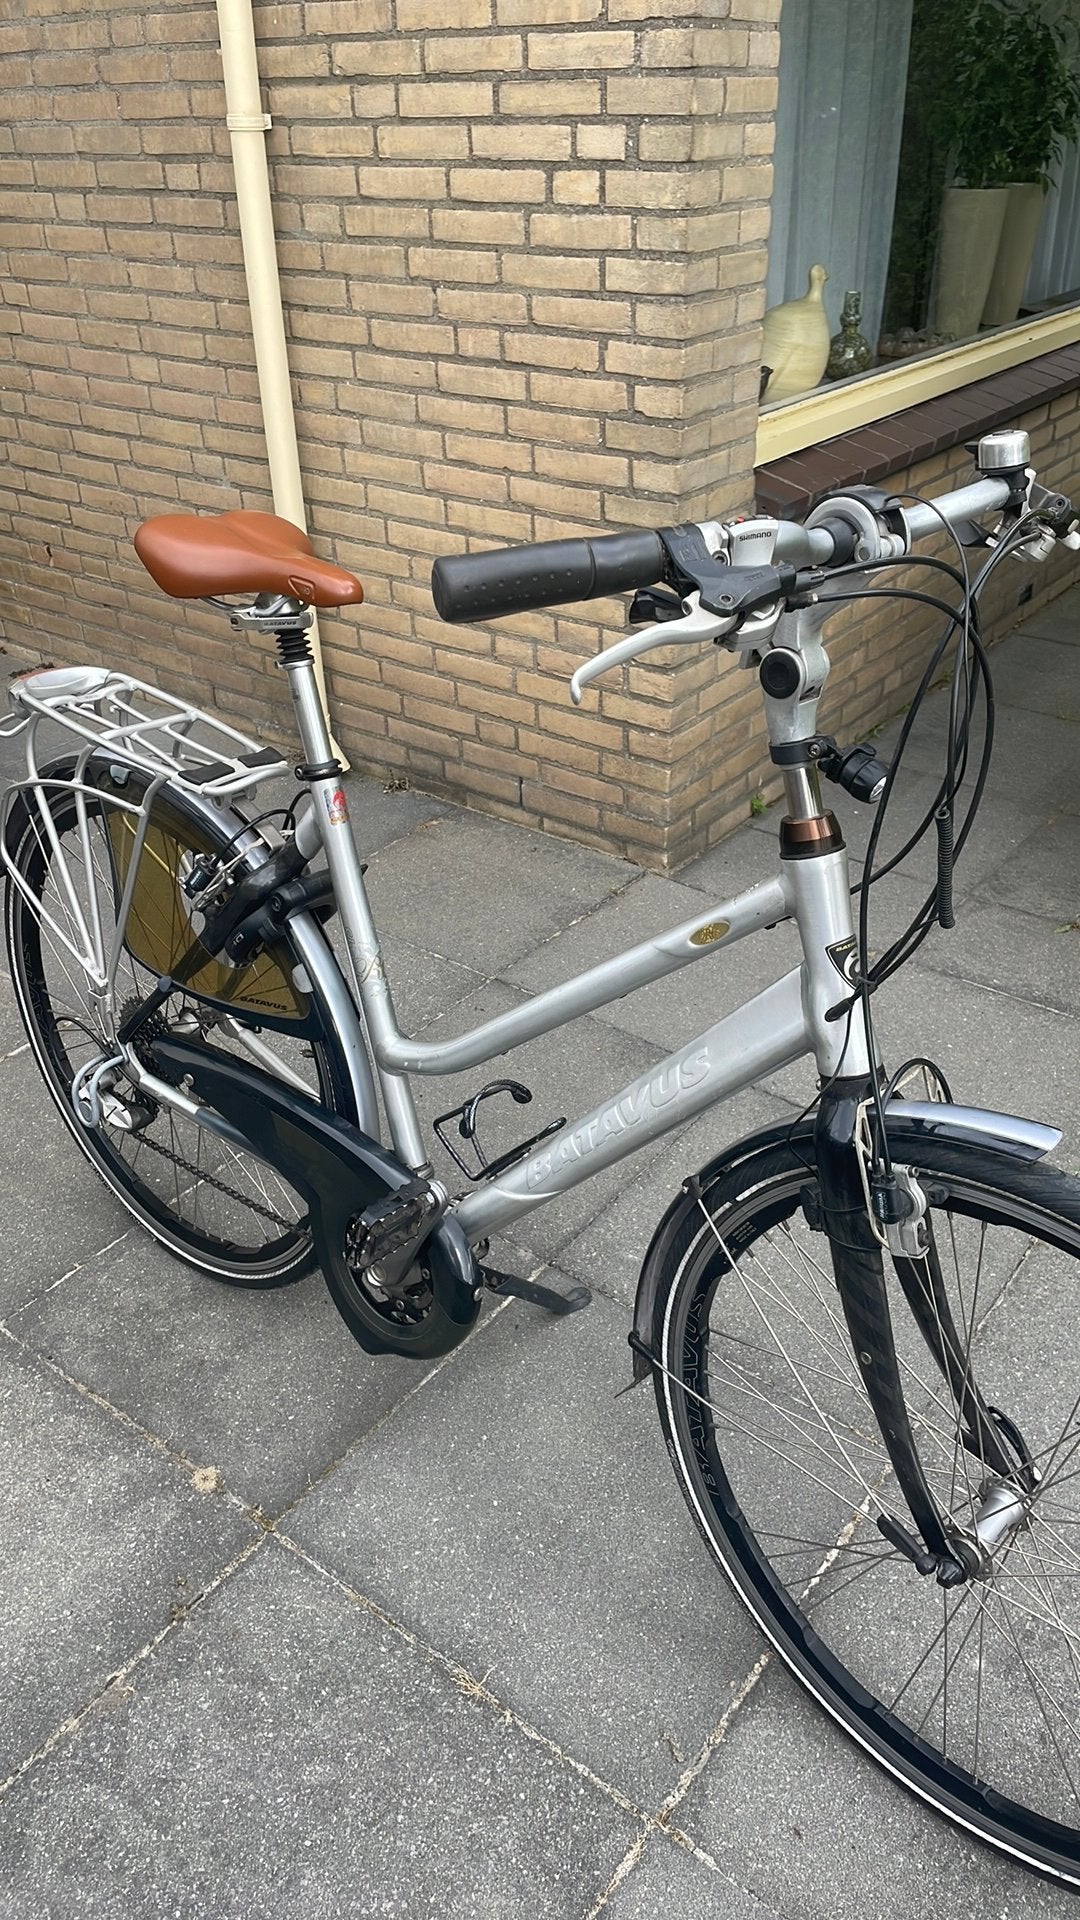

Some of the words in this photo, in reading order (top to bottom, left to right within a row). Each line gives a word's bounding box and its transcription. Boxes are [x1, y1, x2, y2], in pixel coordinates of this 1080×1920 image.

[739, 531, 772, 542] SHIMANO
[240, 996, 288, 1010] BATAVUS
[526, 1046, 711, 1190] BATAVUS
